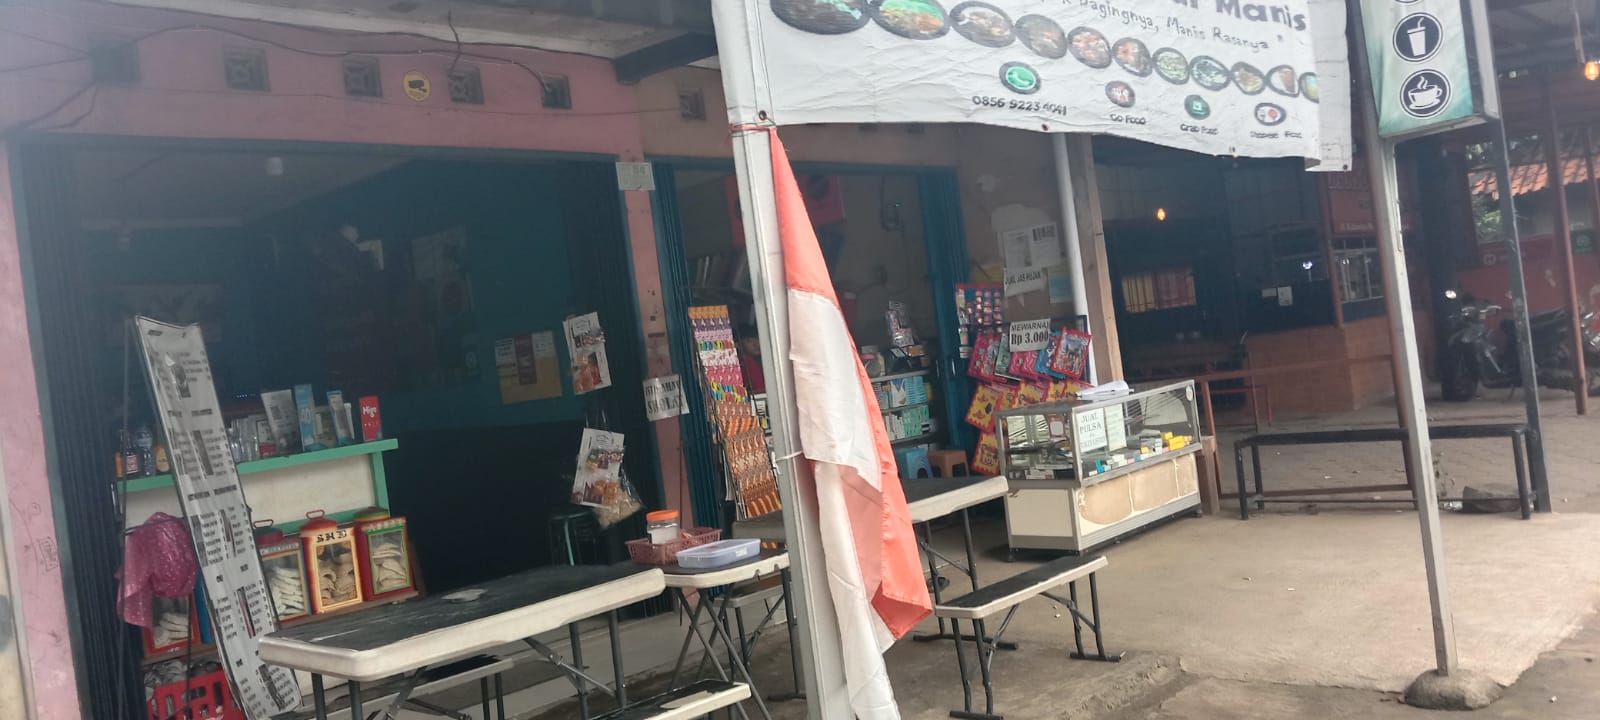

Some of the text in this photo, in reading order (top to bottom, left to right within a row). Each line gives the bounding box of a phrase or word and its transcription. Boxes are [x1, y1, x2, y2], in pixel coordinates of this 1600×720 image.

[1216, 0, 1306, 31] Manis
[1166, 16, 1206, 40] Manis
[972, 95, 1006, 108] 0856
[1009, 99, 1041, 112] 9223
[1011, 320, 1049, 332] MEWARNAI
[1011, 330, 1049, 346] Rp 3.000
